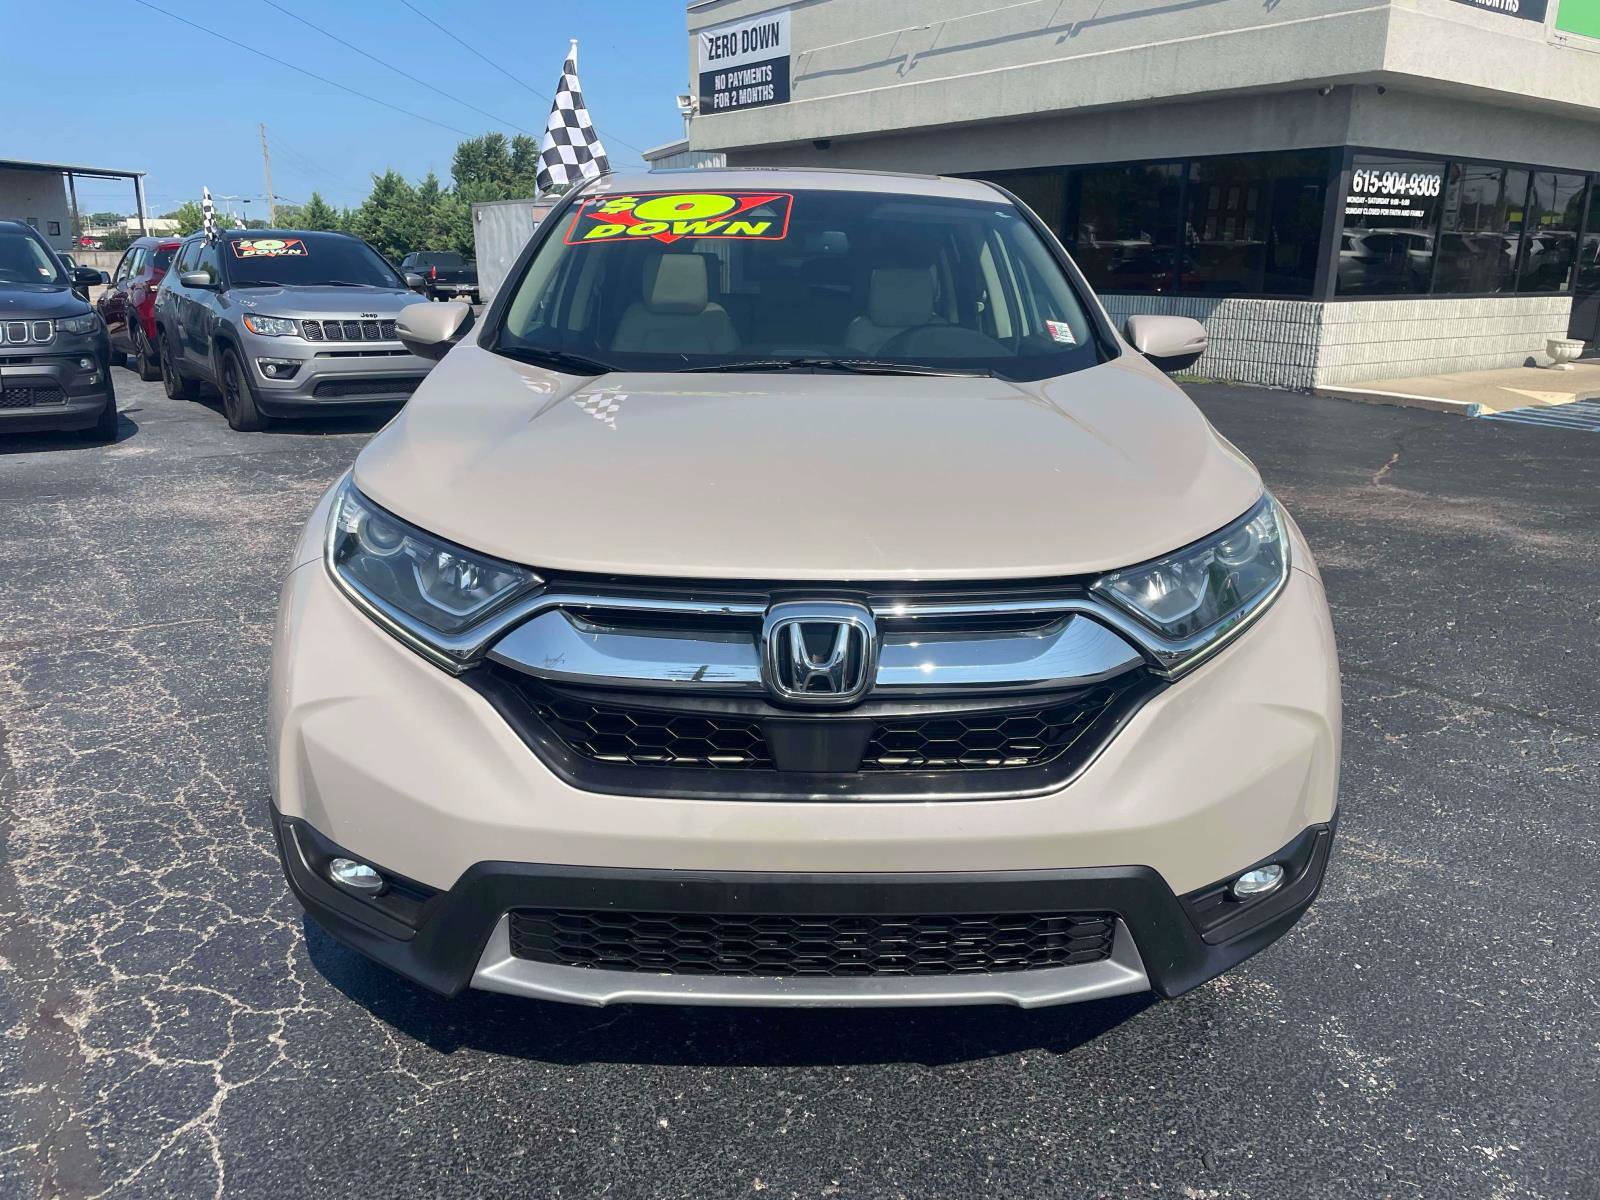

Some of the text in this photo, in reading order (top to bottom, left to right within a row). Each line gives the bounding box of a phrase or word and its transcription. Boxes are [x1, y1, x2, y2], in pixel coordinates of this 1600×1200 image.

[708, 22, 780, 60] ZERO DOWN
[714, 65, 772, 91] NO PAYMENTS
[713, 84, 774, 108] FOR 2 MONTHS
[1352, 168, 1441, 197] 615-904-9303
[1345, 207, 1363, 215] SUNDAY
[1362, 208, 1381, 216] CLOSED
[1346, 196, 1366, 204] MONDAY
[1367, 197, 1390, 205] SATURDAY
[583, 221, 772, 240] DOWN
